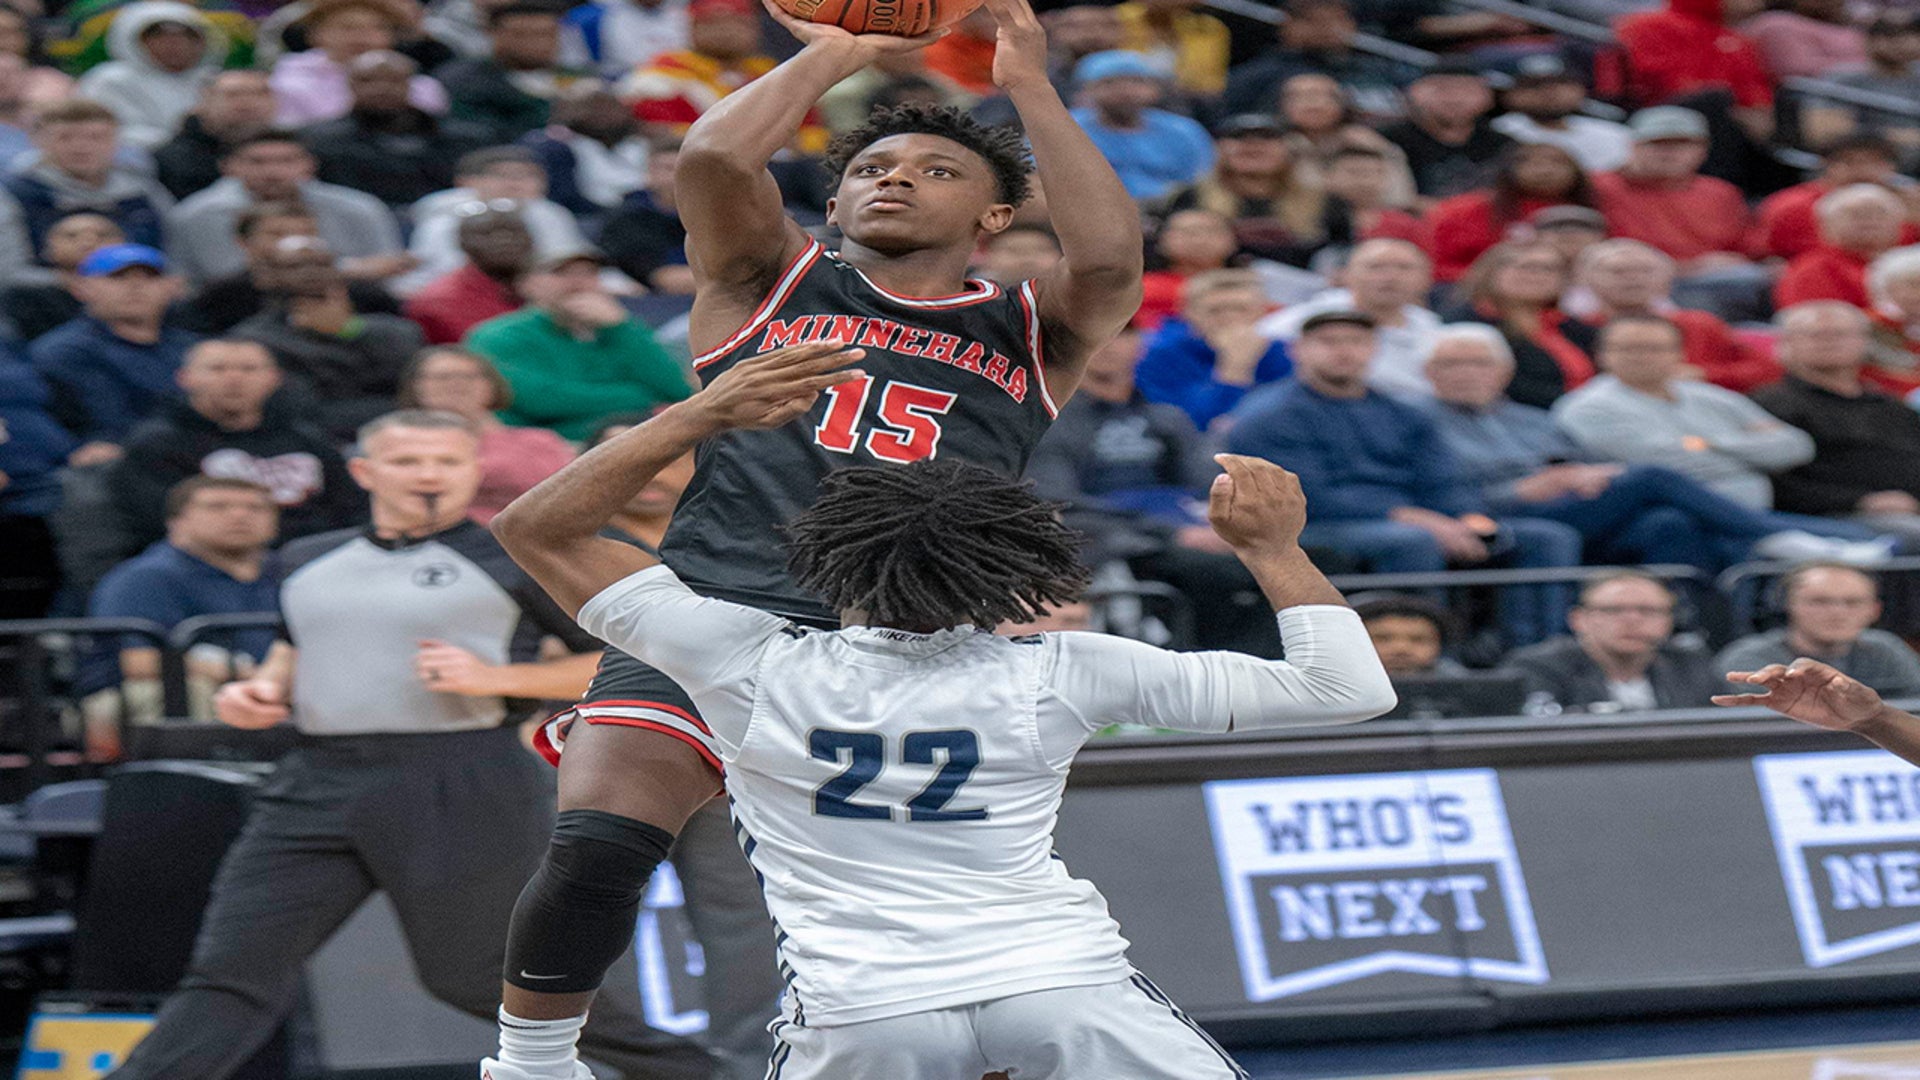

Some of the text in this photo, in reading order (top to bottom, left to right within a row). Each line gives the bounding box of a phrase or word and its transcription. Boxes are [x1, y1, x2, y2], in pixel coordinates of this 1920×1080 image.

[815, 374, 958, 465] 15
[804, 726, 991, 822] 22
[1797, 771, 1920, 825] WH
[1248, 793, 1473, 854] WHO'S
[1270, 874, 1489, 943] NEXT
